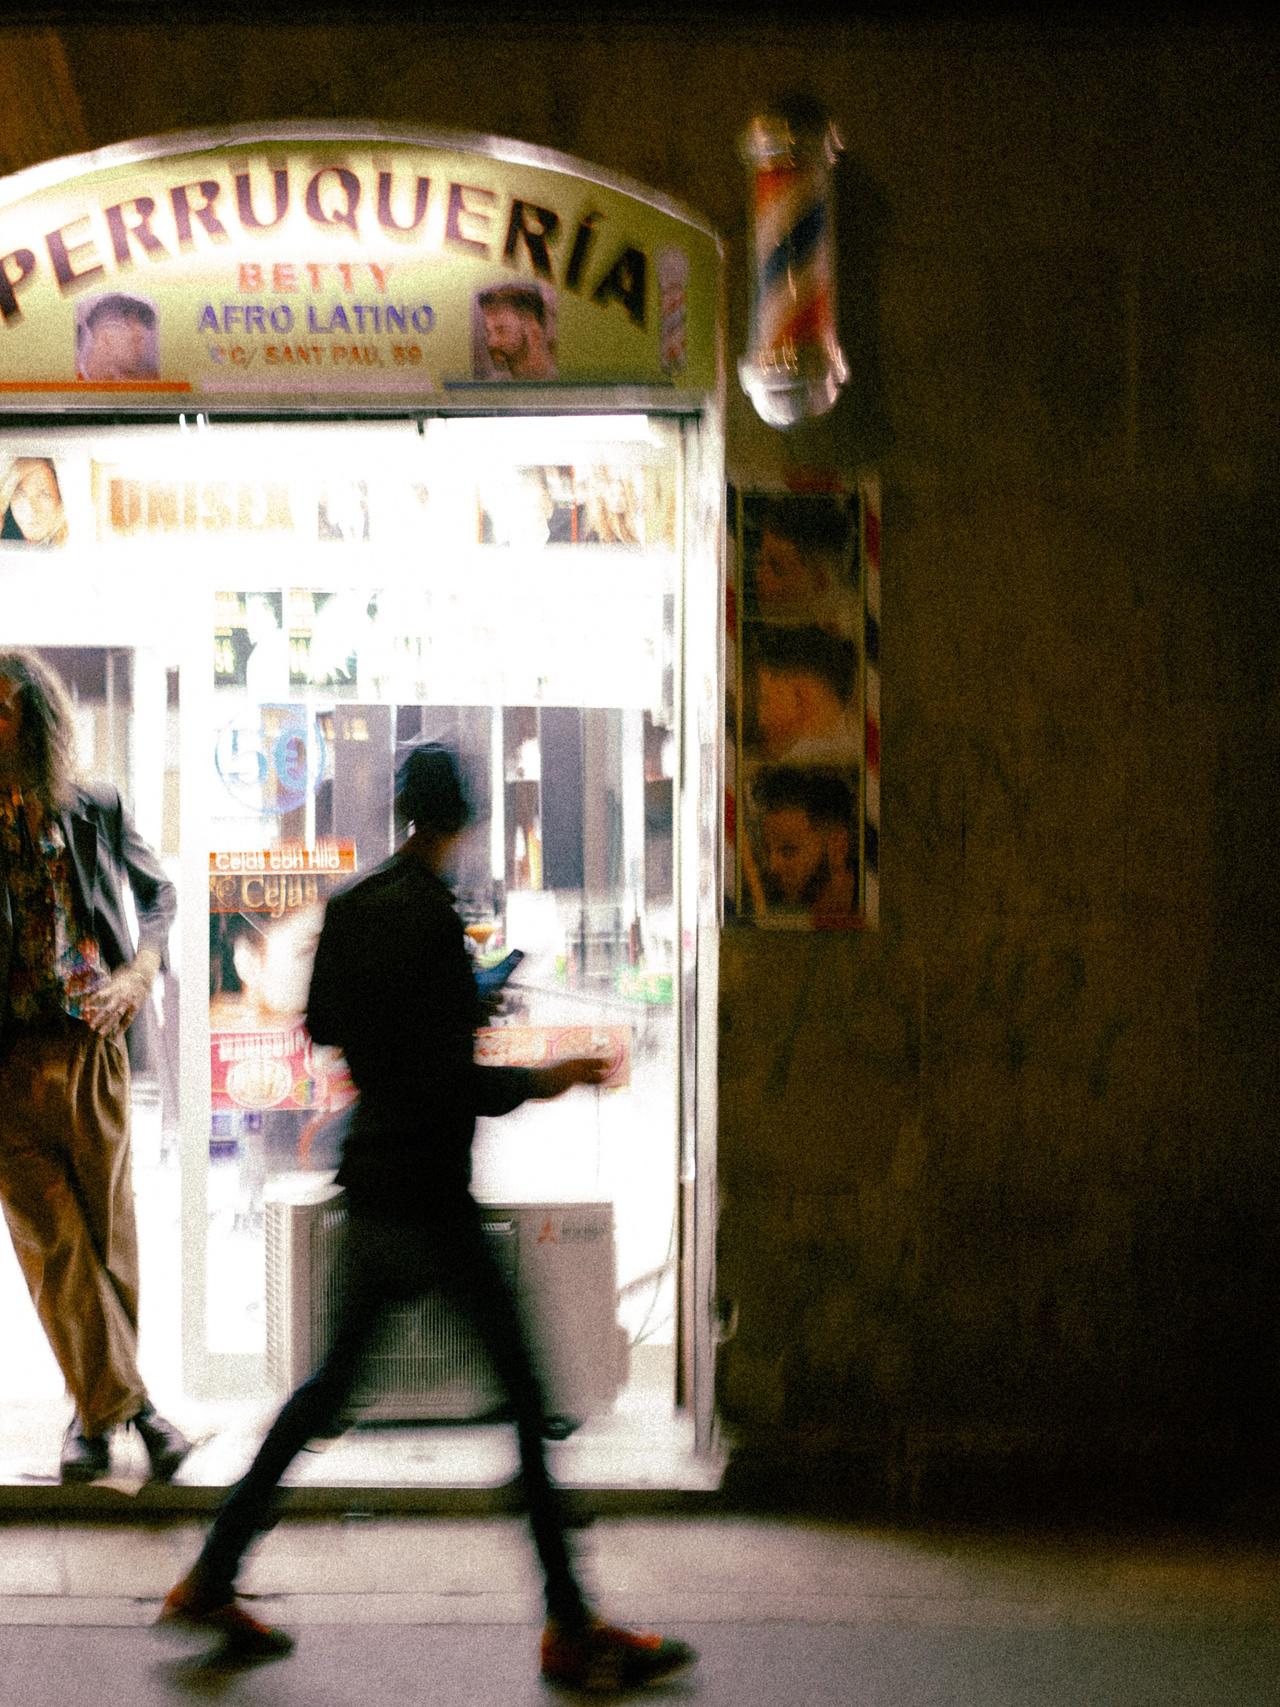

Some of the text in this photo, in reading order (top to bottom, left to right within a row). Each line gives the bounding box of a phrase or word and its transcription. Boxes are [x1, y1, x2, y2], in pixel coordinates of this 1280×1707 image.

[237, 262, 395, 294] BETTY
[197, 304, 436, 335] AFRO LATINO
[265, 346, 325, 366] SANT
[215, 849, 340, 873] Cejas con Hilo
